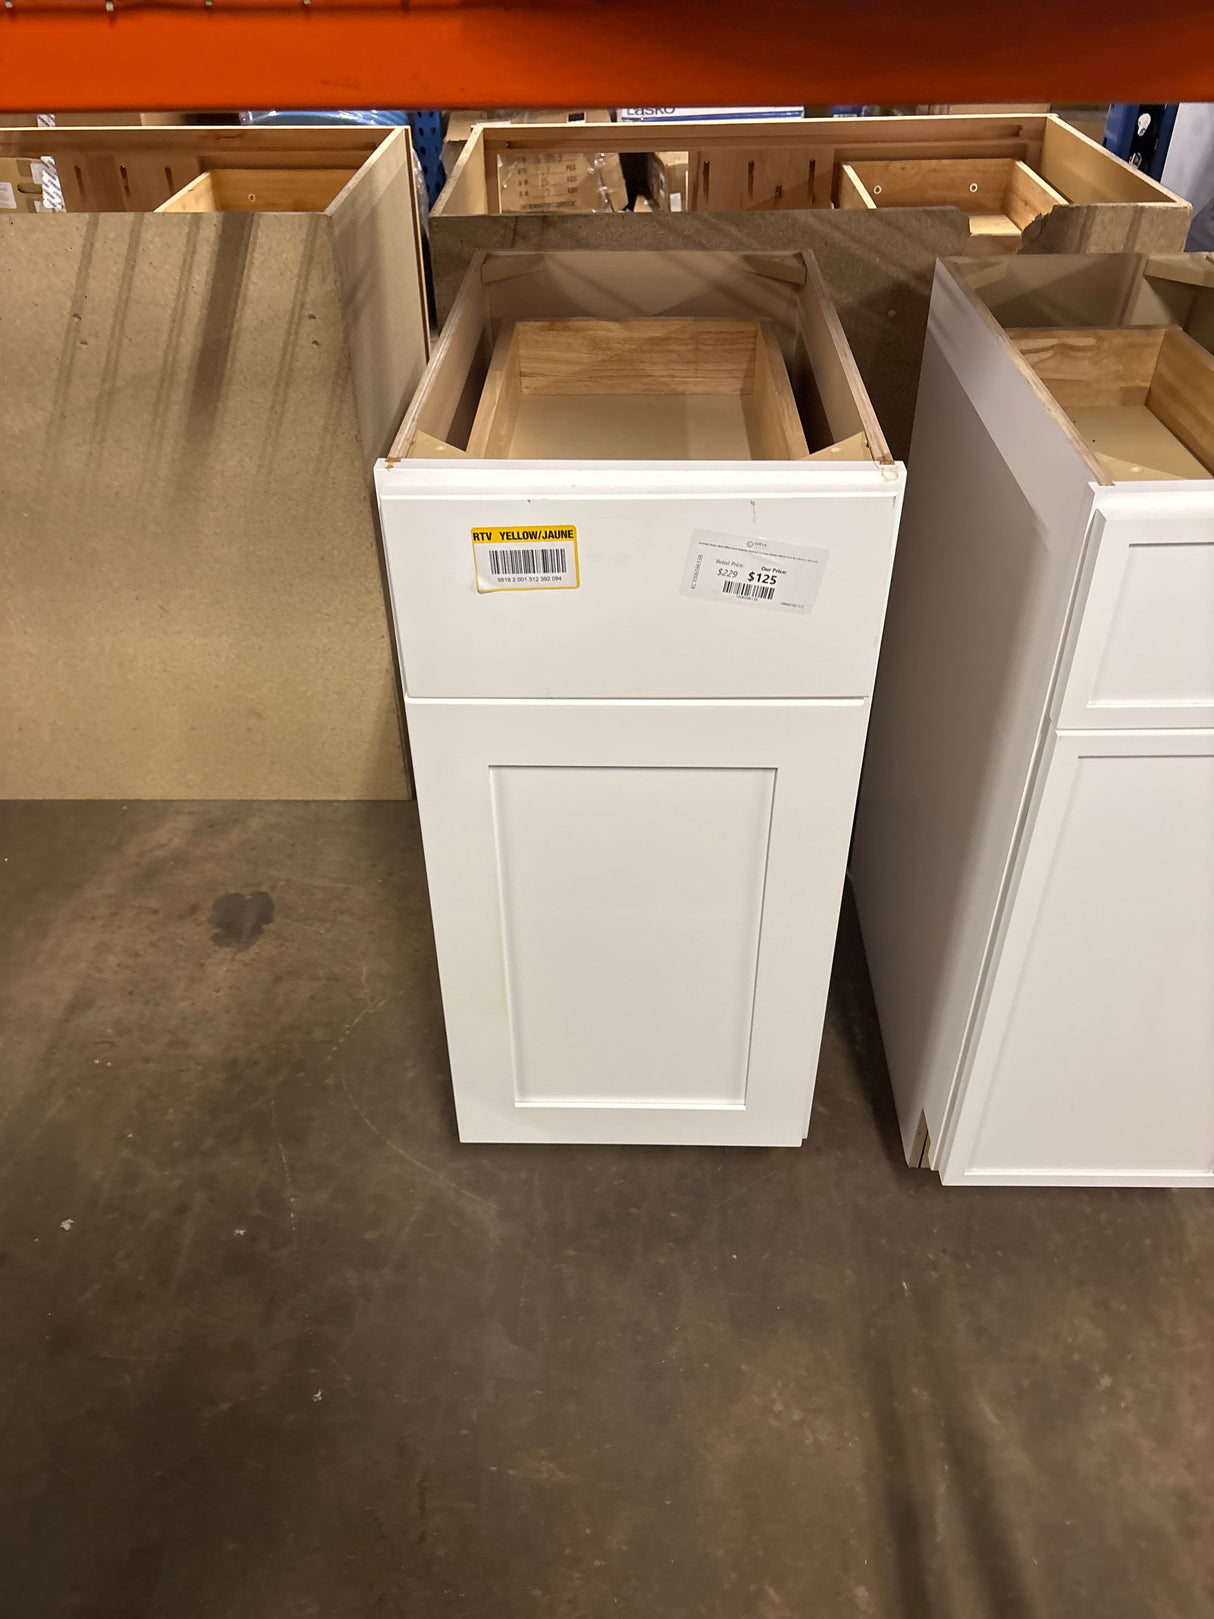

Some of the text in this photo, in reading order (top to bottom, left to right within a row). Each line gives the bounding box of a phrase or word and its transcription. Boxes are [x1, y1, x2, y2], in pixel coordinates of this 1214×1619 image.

[472, 530, 574, 541] RTV YELLOW/JAUNE
[716, 559, 731, 567] Retail
[717, 568, 739, 579] $229
[772, 567, 788, 575] Price:
[747, 572, 778, 585] $125
